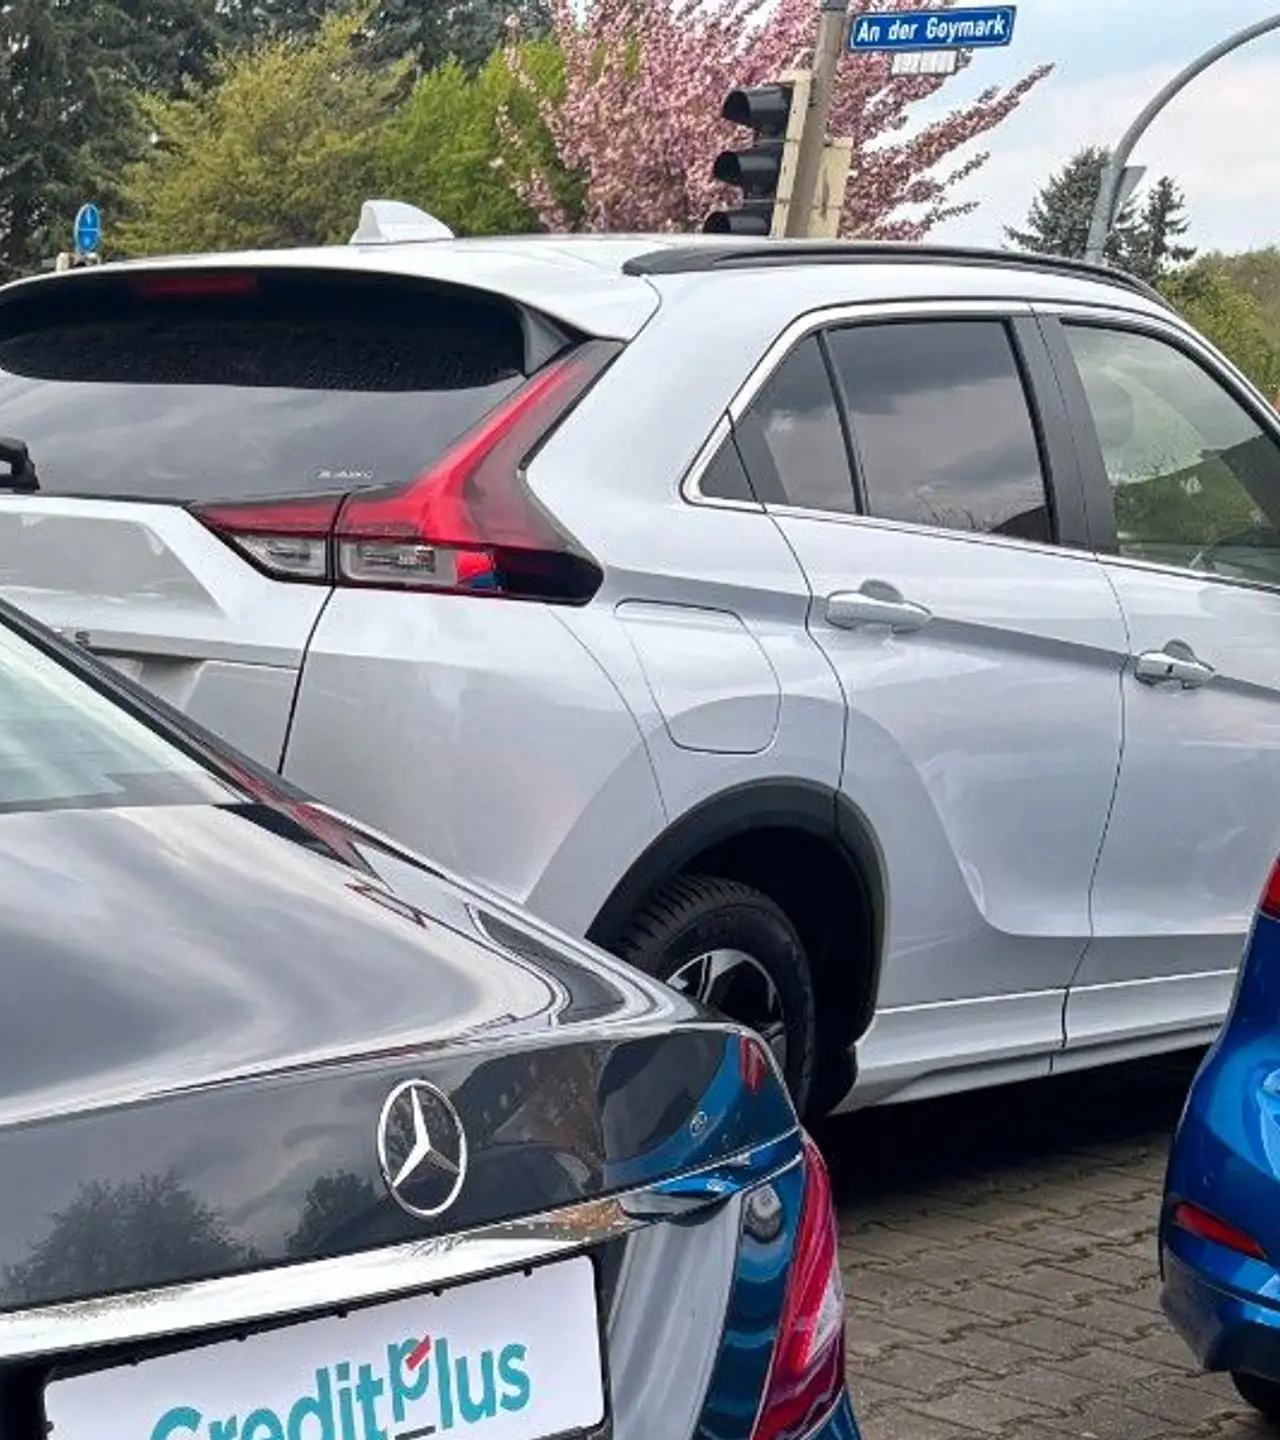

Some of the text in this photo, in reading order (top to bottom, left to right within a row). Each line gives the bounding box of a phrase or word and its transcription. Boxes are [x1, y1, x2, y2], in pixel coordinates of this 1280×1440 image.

[857, 14, 1005, 43] An der Goymark
